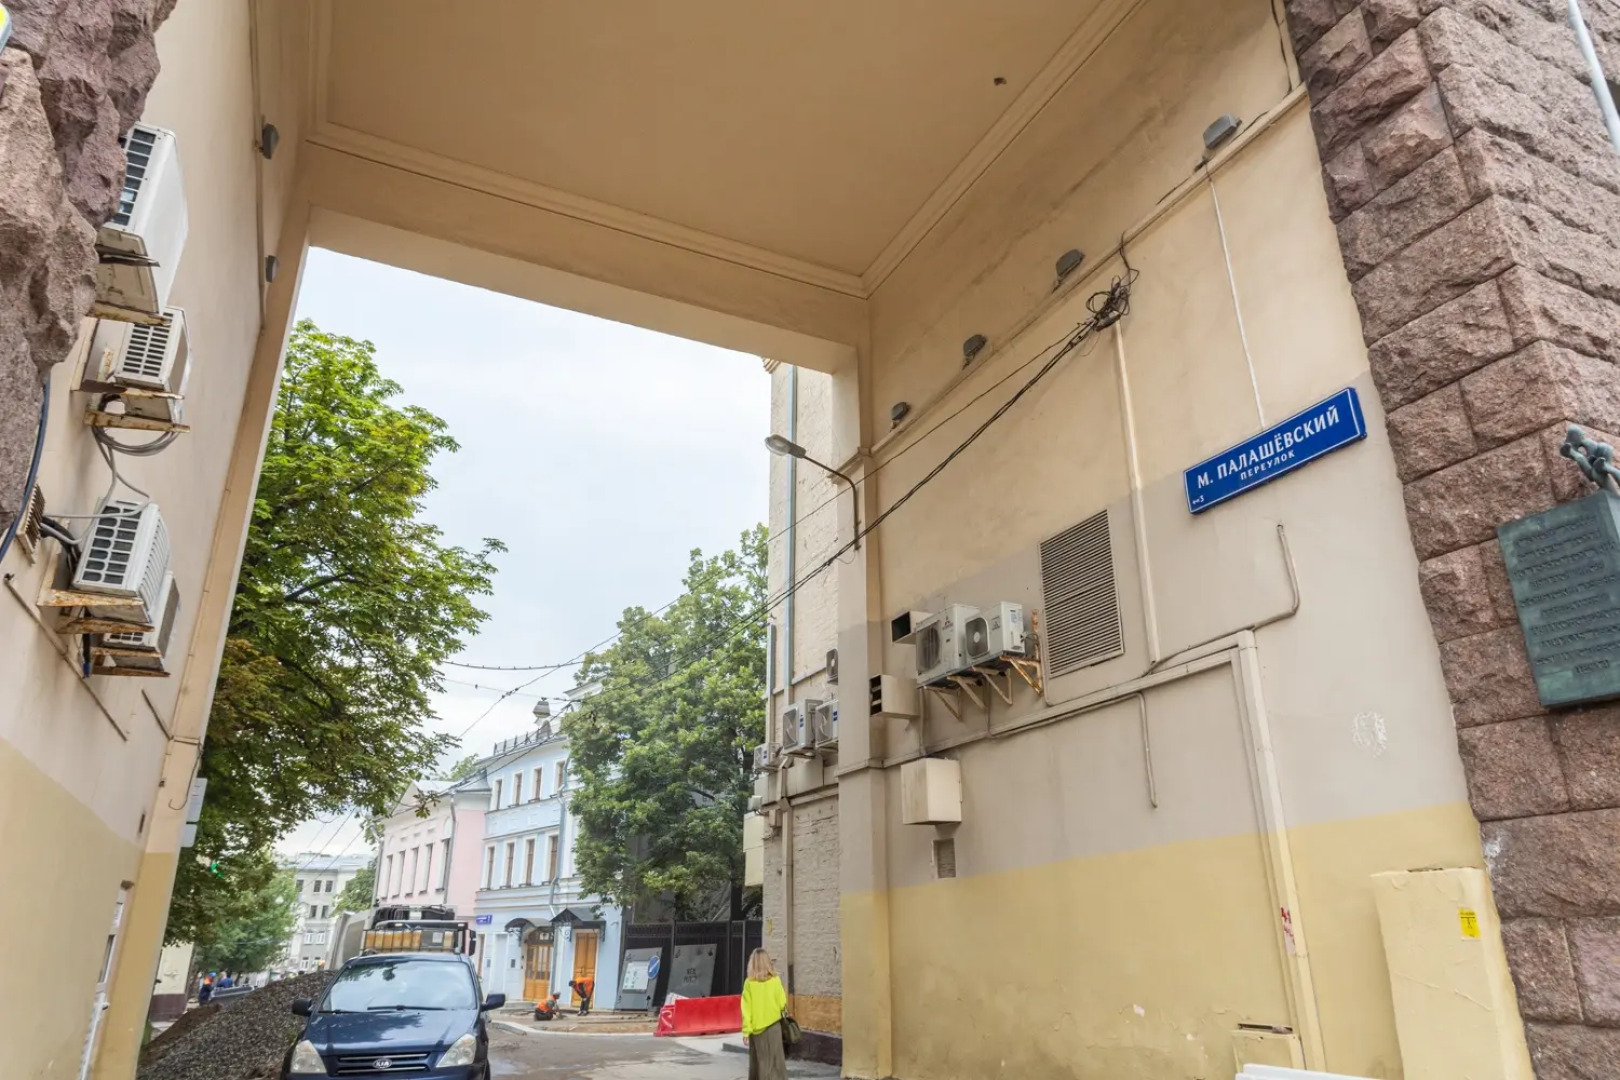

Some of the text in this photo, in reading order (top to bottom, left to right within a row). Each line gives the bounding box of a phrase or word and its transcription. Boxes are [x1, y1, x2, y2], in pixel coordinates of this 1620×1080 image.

[1197, 404, 1340, 489] М. ПАЛАШЁВСКИЙ
[1240, 449, 1295, 480] ПЕРЕУЛОК
